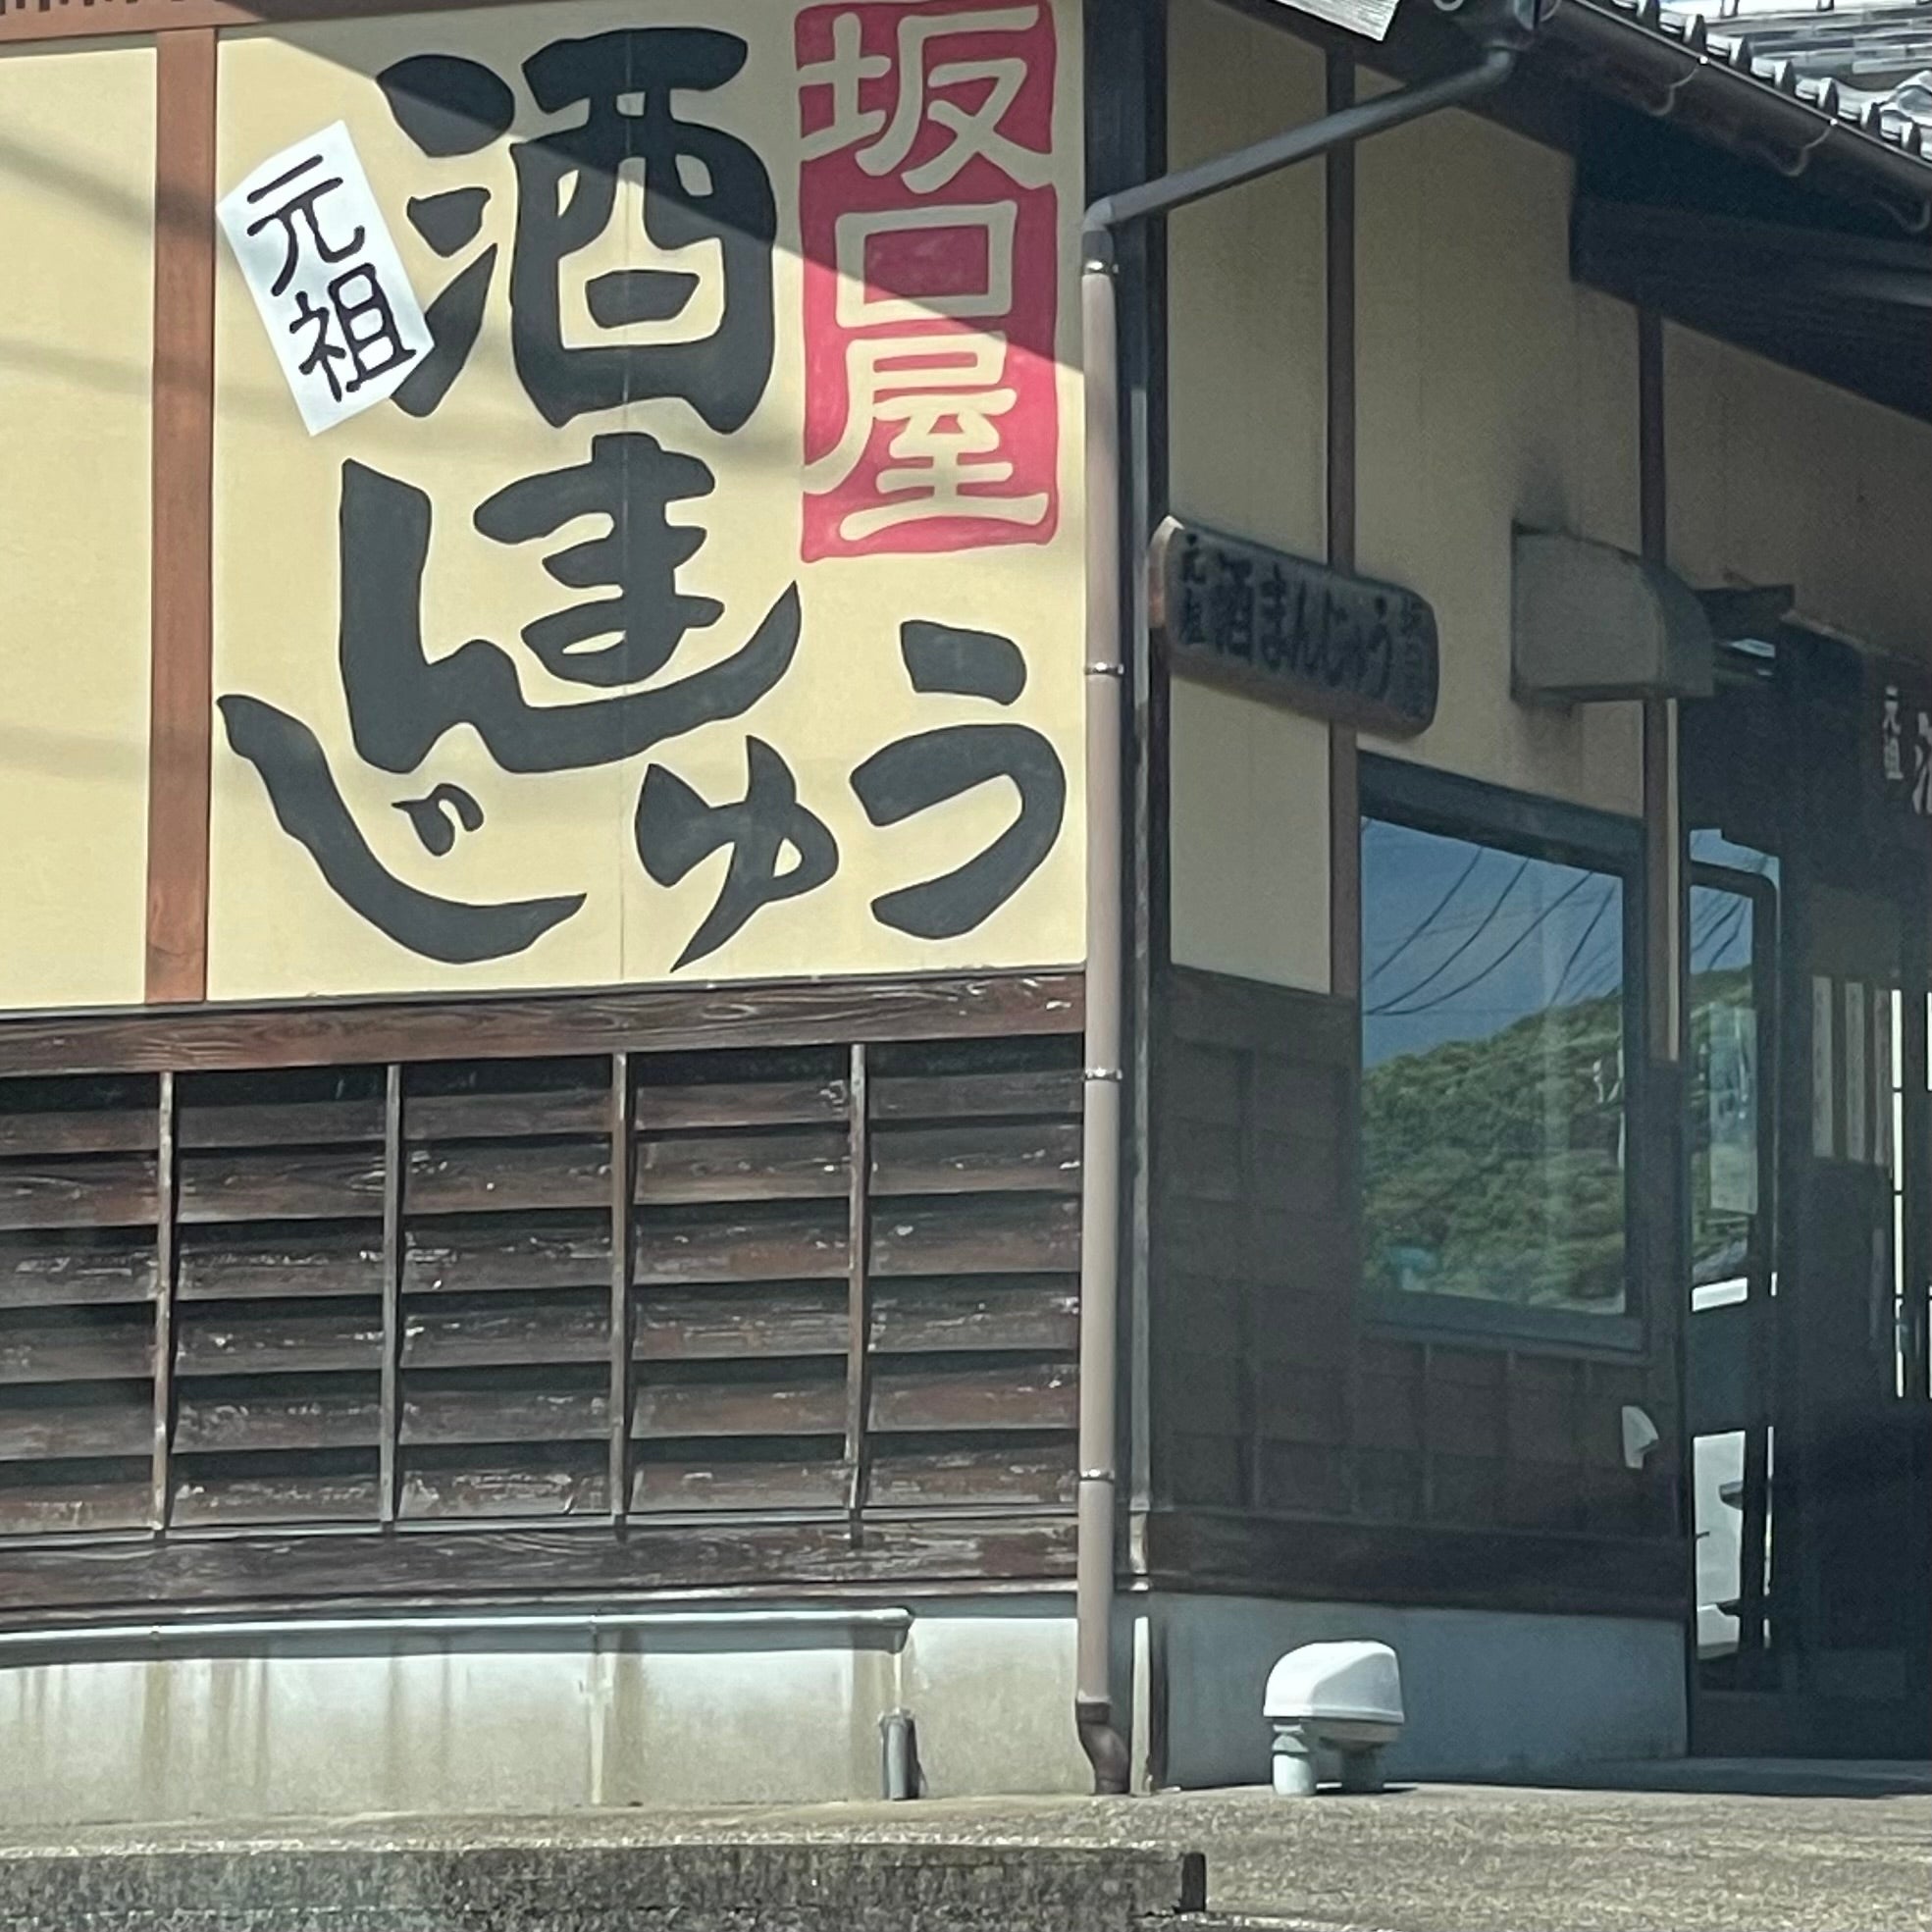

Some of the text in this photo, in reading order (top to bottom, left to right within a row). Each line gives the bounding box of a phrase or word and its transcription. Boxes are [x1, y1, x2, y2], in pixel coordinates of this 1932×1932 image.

[246, 154, 417, 402] 元祖
[798, 5, 1054, 542] 坂口屋
